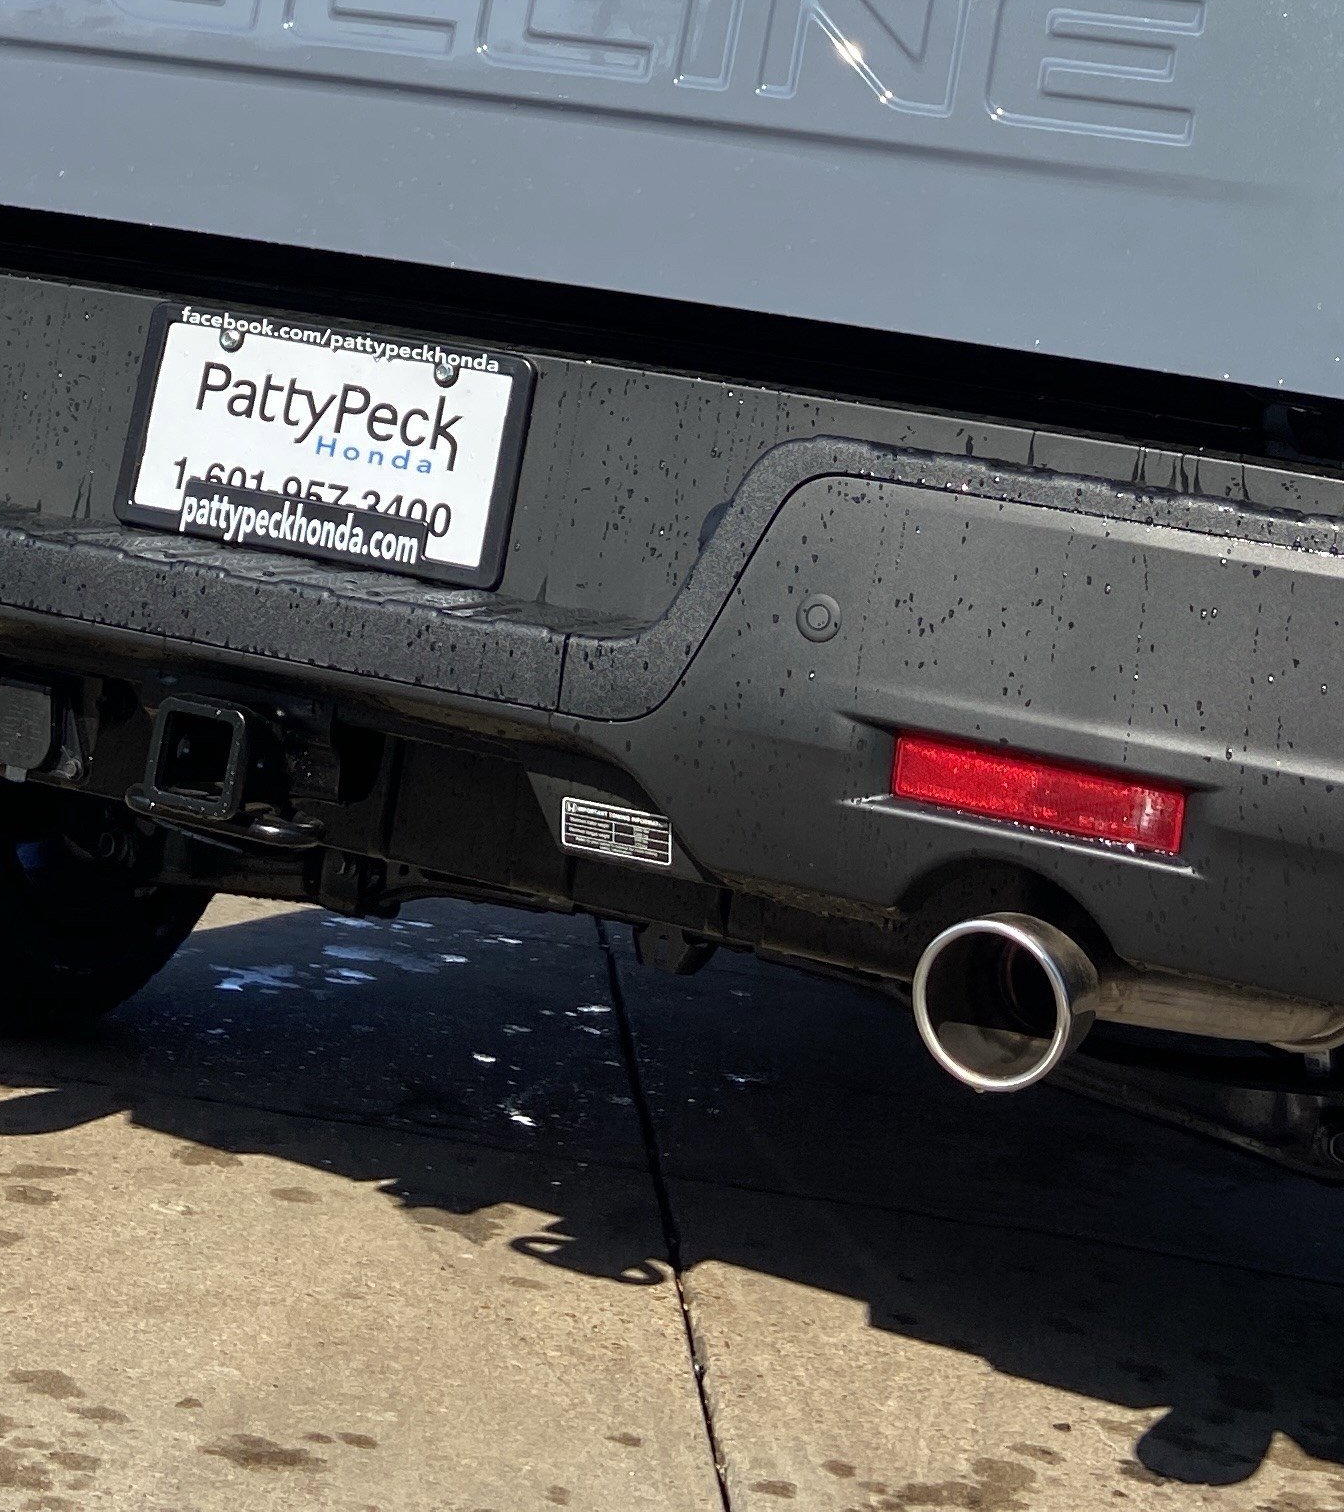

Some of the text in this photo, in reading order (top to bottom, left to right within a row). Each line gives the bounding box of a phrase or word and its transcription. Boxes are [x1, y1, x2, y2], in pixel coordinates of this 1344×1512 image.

[181, 306, 499, 373] facebook.com/pattypeckhonda
[195, 361, 464, 472] PattyPeck
[315, 435, 433, 474] Honda
[179, 494, 419, 565] pattypeckhonda.com
